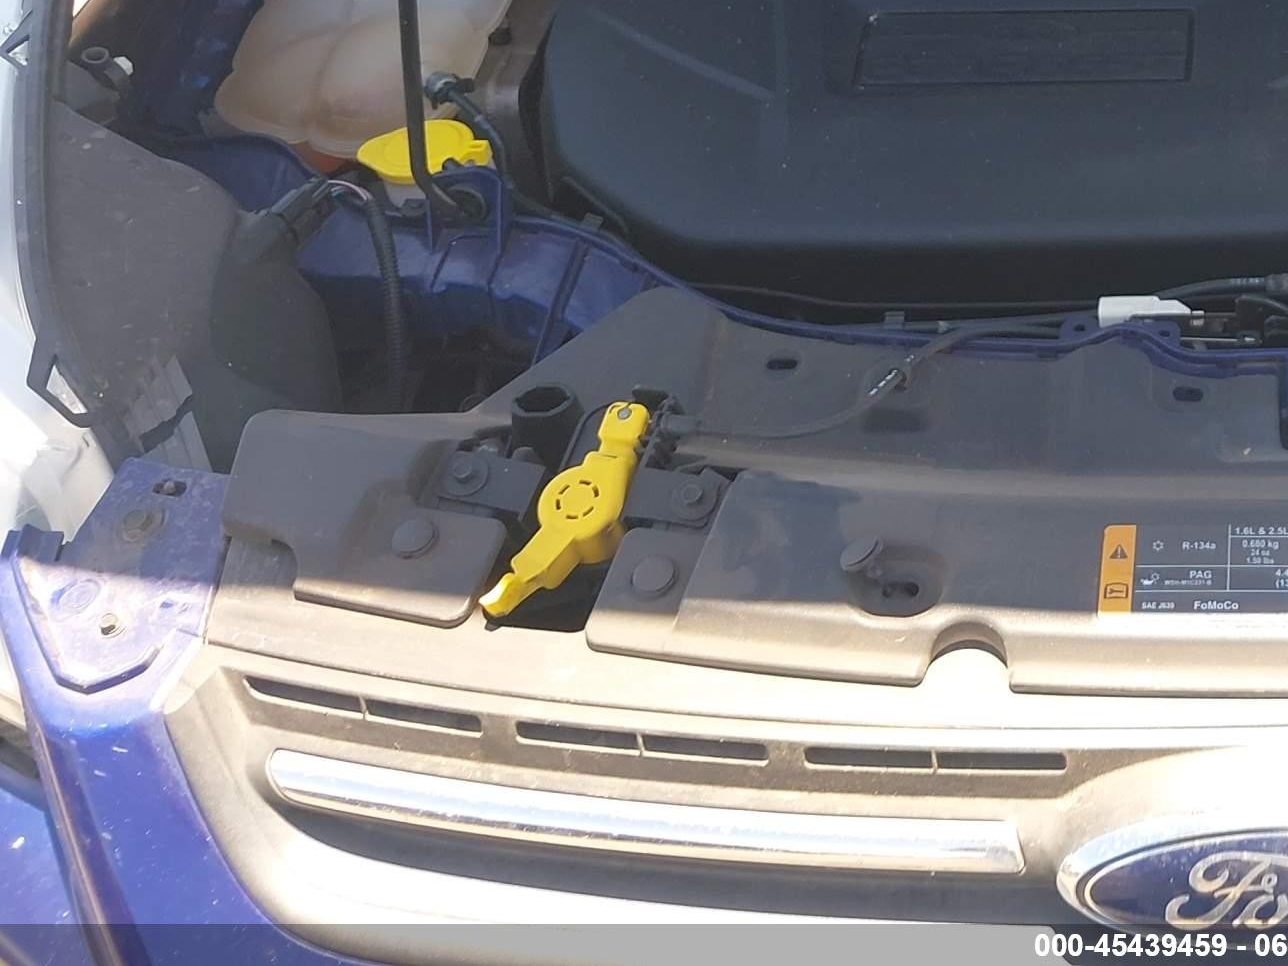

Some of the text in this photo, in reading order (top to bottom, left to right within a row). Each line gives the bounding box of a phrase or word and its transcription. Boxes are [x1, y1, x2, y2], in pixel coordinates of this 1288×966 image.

[1235, 526, 1288, 535] 1.6L & 2.5L
[1181, 540, 1217, 550] R-134a
[1267, 539, 1280, 550] kg
[1189, 570, 1212, 579] PAG
[1141, 601, 1157, 609] SAE
[1193, 600, 1239, 610] FoMoCo
